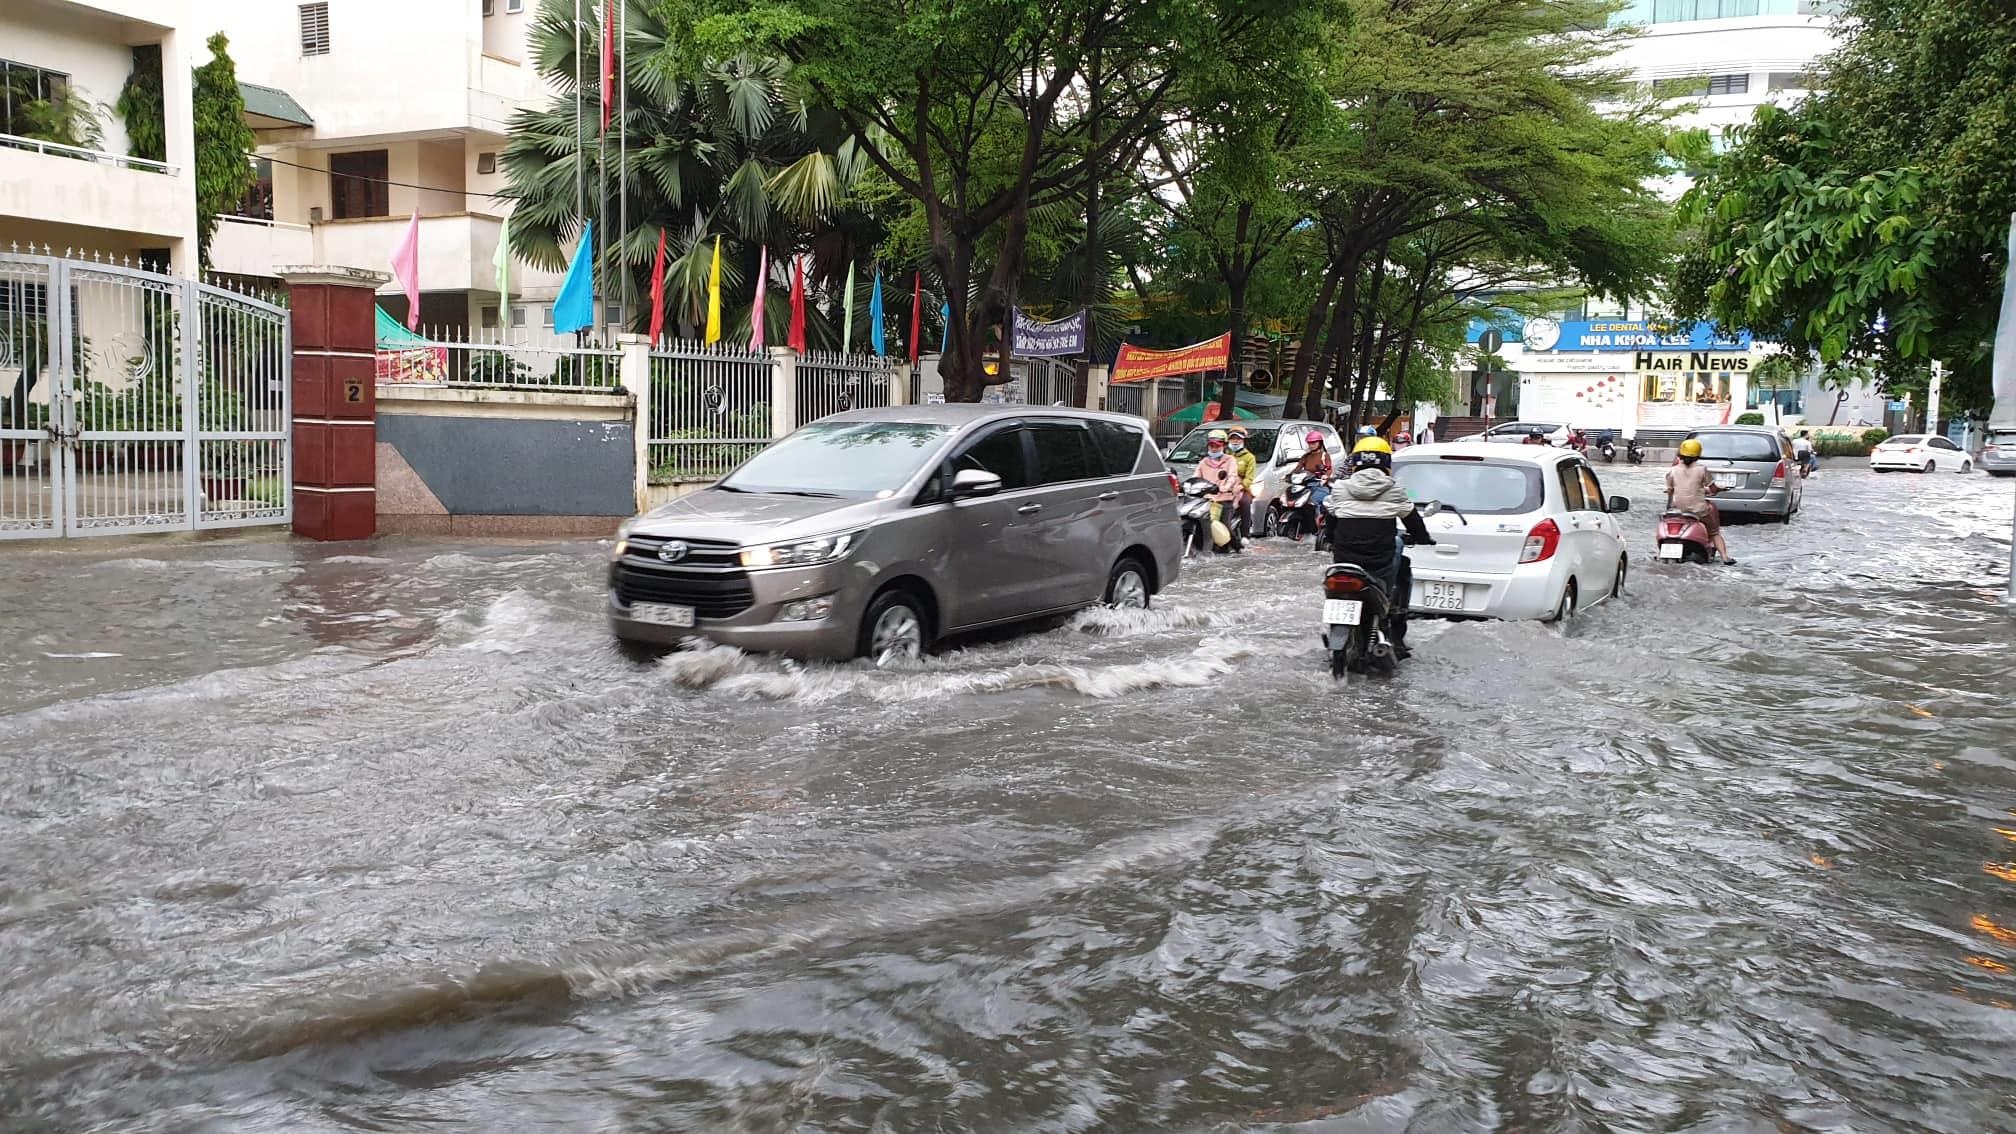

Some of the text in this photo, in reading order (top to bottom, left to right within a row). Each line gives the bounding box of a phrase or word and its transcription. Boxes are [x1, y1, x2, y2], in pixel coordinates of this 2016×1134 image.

[1589, 323, 1607, 332] LEE
[1609, 323, 1645, 332] DENTAL
[1580, 335, 1611, 346] NHA
[1614, 335, 1657, 346] KHOA
[349, 385, 360, 401] 2
[1433, 583, 1455, 596] 51G
[1424, 595, 1463, 609] 07262
